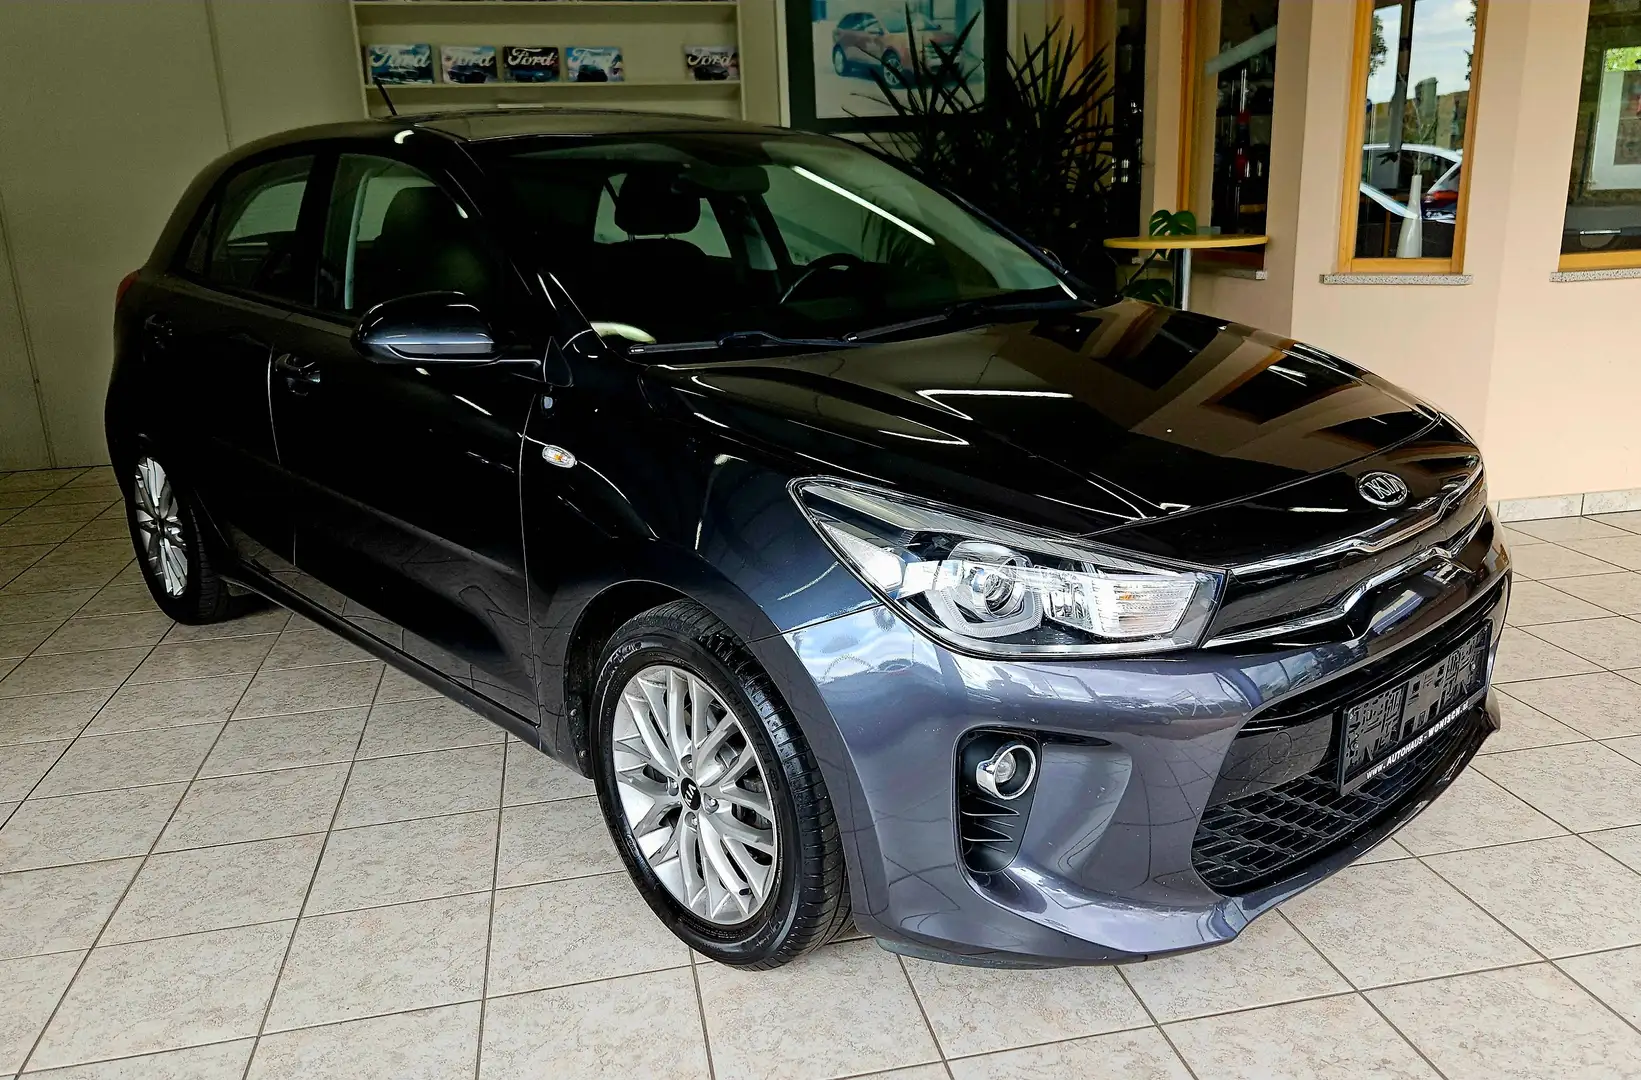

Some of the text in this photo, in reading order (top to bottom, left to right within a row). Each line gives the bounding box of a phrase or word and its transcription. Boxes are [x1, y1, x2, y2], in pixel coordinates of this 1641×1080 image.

[507, 47, 555, 66] Ford
[687, 47, 736, 67] Ford
[1364, 475, 1405, 500] KIA
[684, 783, 697, 807] KIA
